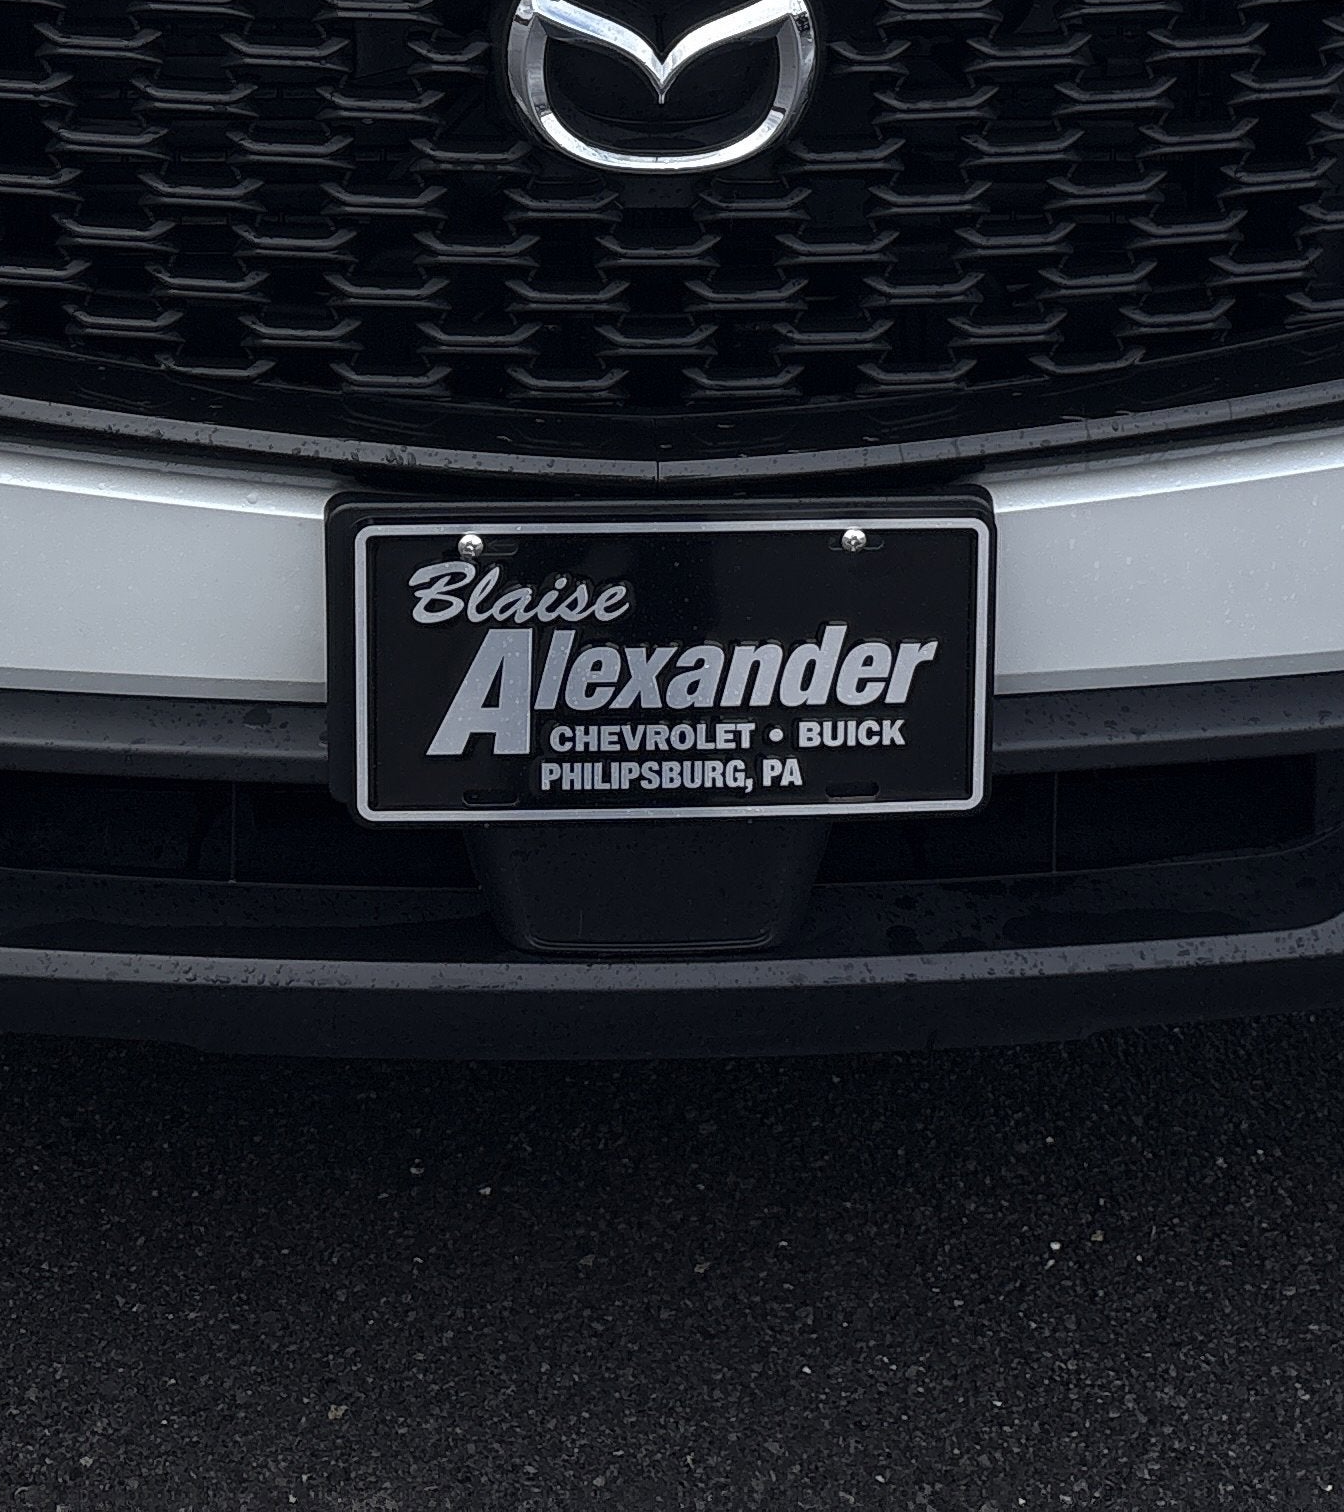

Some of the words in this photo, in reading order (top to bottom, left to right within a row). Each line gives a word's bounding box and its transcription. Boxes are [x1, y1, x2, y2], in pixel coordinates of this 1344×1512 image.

[408, 561, 631, 624] Blaise
[426, 624, 938, 756] Alexander
[549, 723, 756, 752] CHEVROLET
[798, 720, 906, 748] BUICK
[541, 760, 754, 793] PHILIPSBURG,
[762, 758, 803, 788] PA
